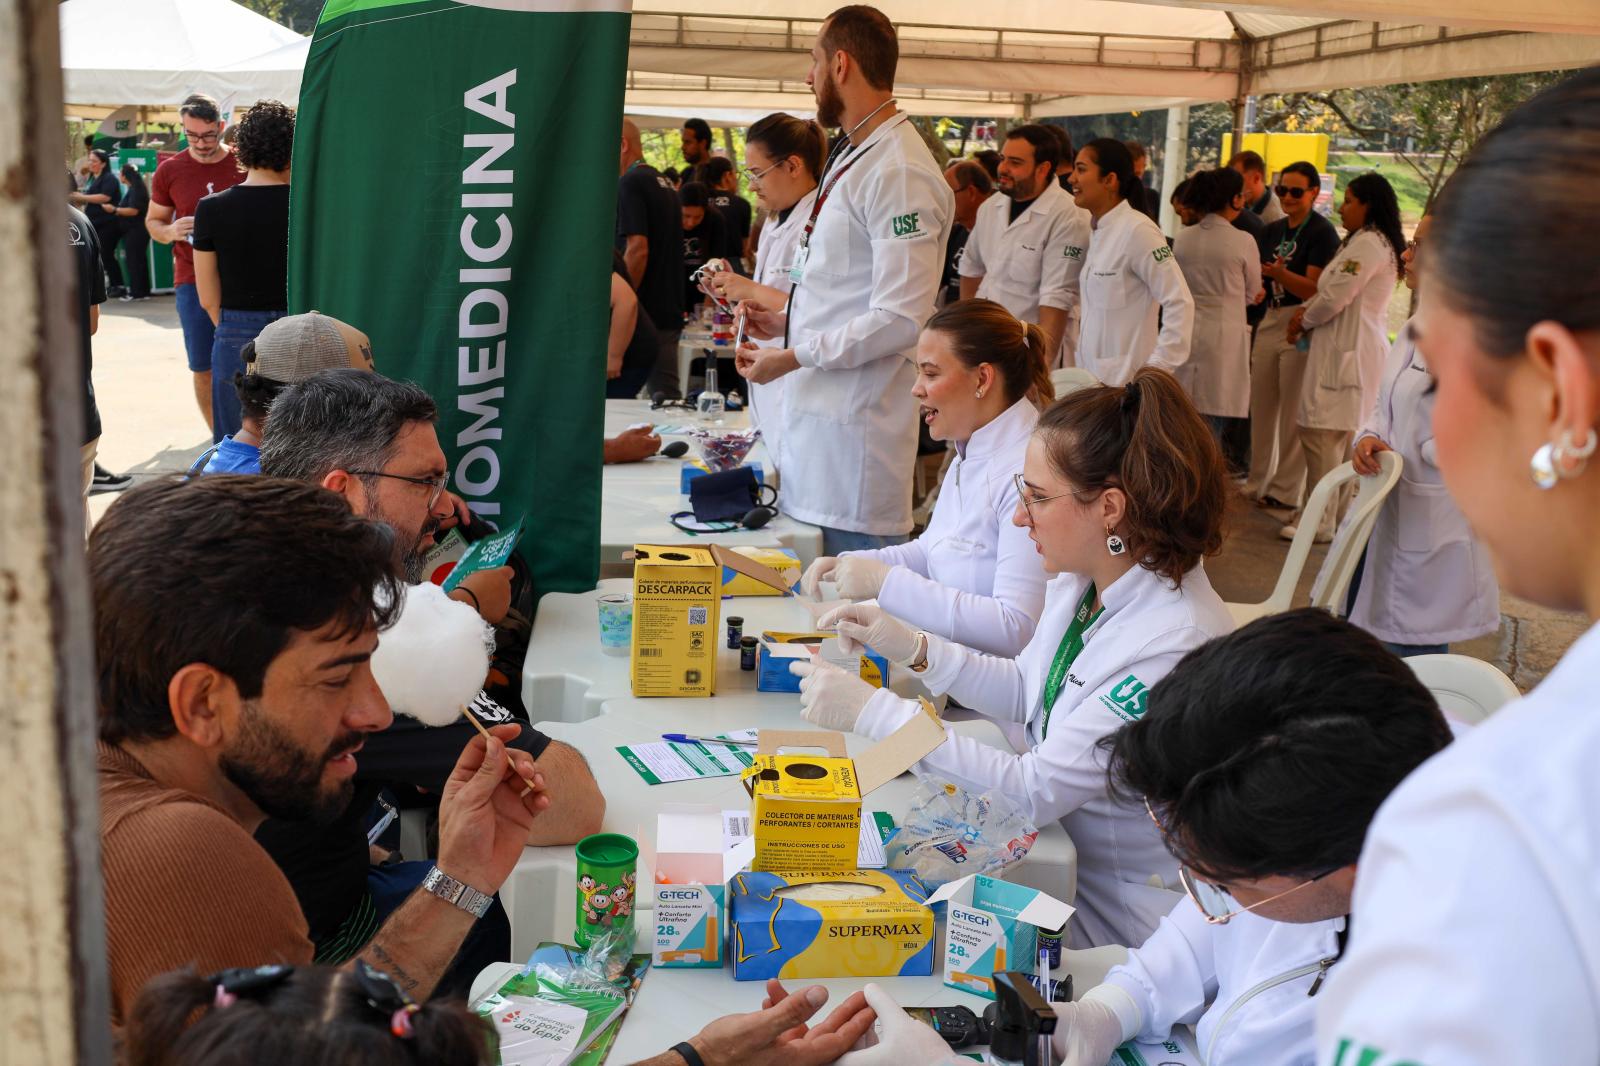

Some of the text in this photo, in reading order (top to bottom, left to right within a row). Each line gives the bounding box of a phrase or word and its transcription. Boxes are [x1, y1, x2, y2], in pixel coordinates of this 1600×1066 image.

[892, 212, 920, 237] USF
[1063, 245, 1084, 258] USF
[454, 68, 517, 533] IOMEDICINA
[638, 585, 712, 595] DESCARPACK
[1076, 603, 1090, 622] USF
[1110, 674, 1150, 715] US
[840, 766, 853, 788] ATENÇÃO
[765, 811, 804, 820] COLECTOR
[816, 813, 854, 821] MATERIAIS
[759, 819, 811, 829] PERFORANTES
[816, 821, 859, 829] CORTANTES
[767, 841, 820, 849] INSTRUCCIONES
[828, 923, 922, 939] SUPERMAX
[955, 931, 982, 942] Conforto
[903, 941, 918, 949] MÉDIA
[514, 1023, 563, 1041] do lápis
[536, 1022, 570, 1035] ponta
